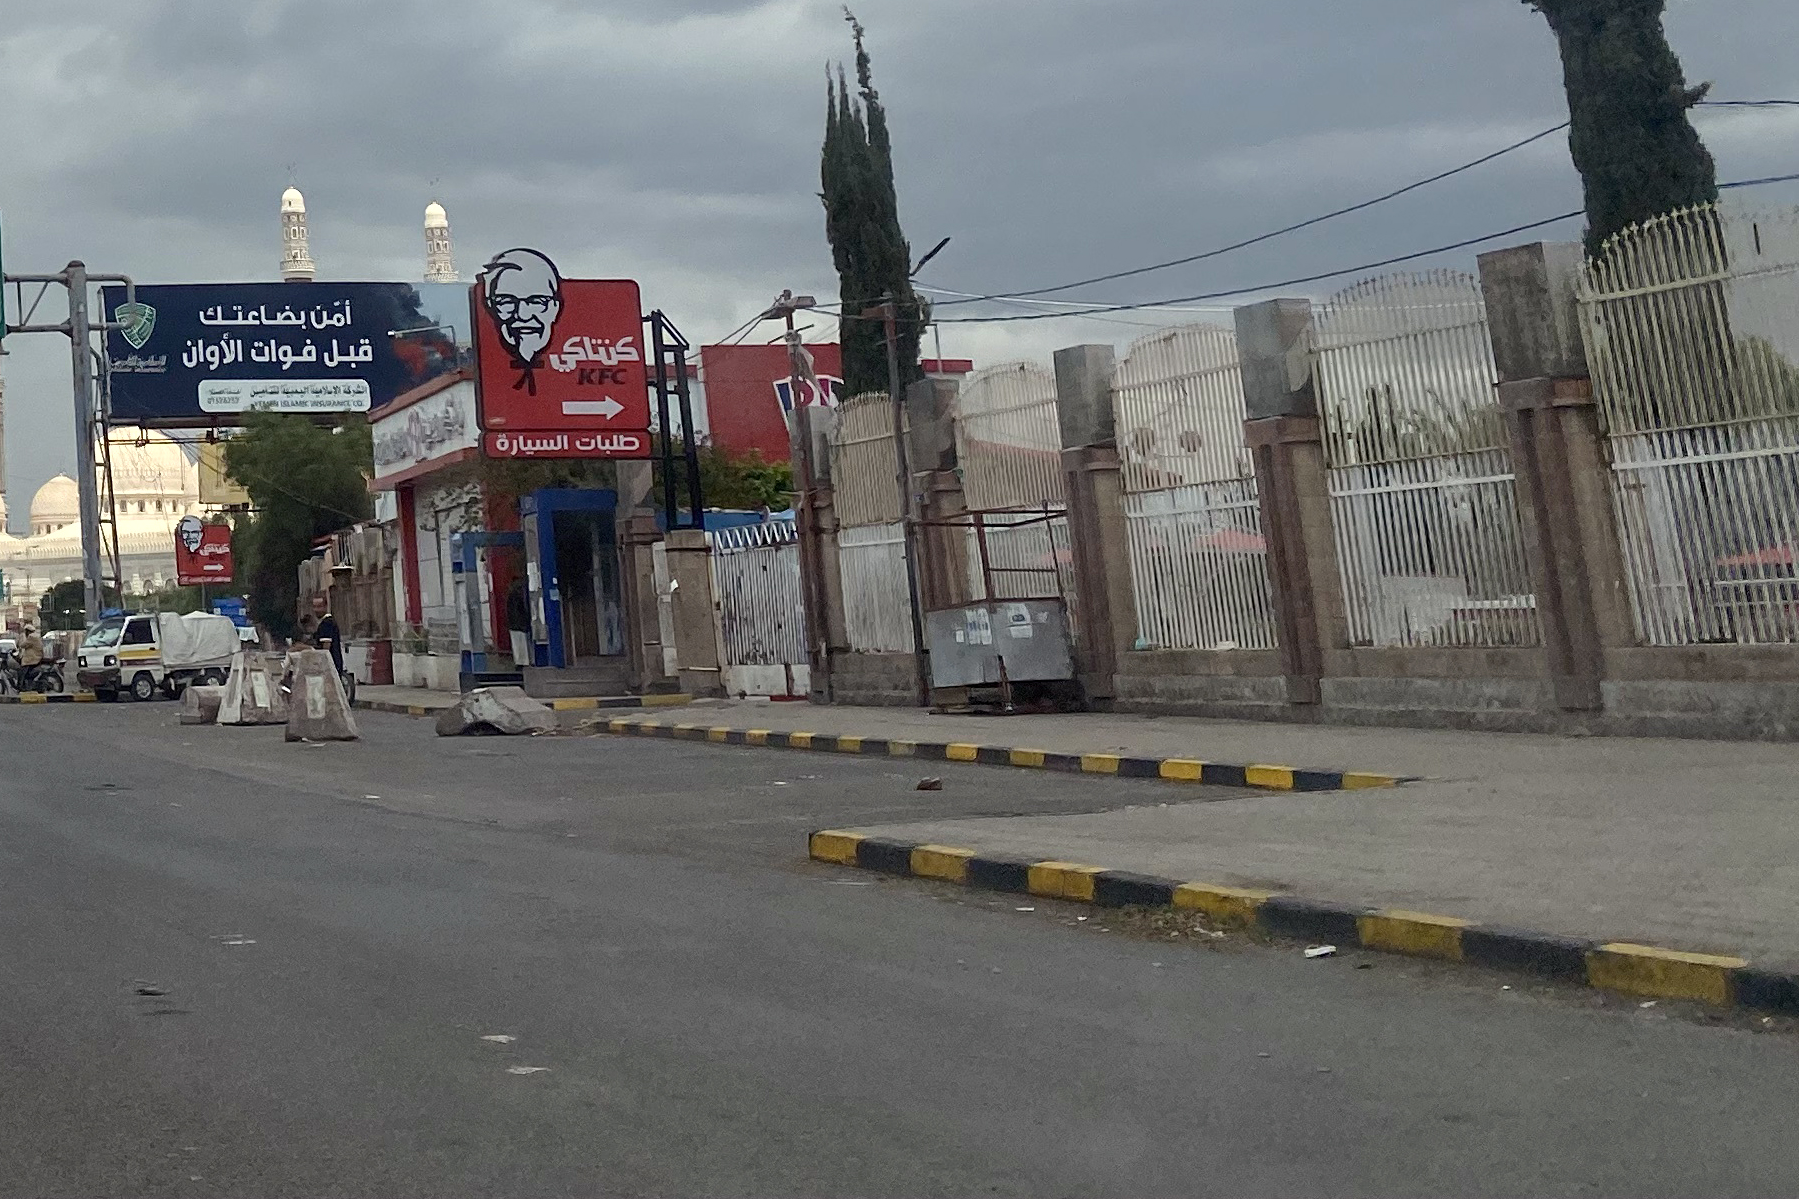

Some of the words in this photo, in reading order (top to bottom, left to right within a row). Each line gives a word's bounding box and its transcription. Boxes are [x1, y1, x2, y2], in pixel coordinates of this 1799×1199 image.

[199, 305, 307, 330] بضاعتك
[182, 331, 244, 371] الأوان
[250, 339, 317, 370] فوات
[323, 338, 373, 368] قبل
[549, 336, 640, 373] كنتاكي
[577, 367, 627, 385] KFC
[495, 433, 569, 456] السيارة
[575, 434, 640, 455] طلبات
